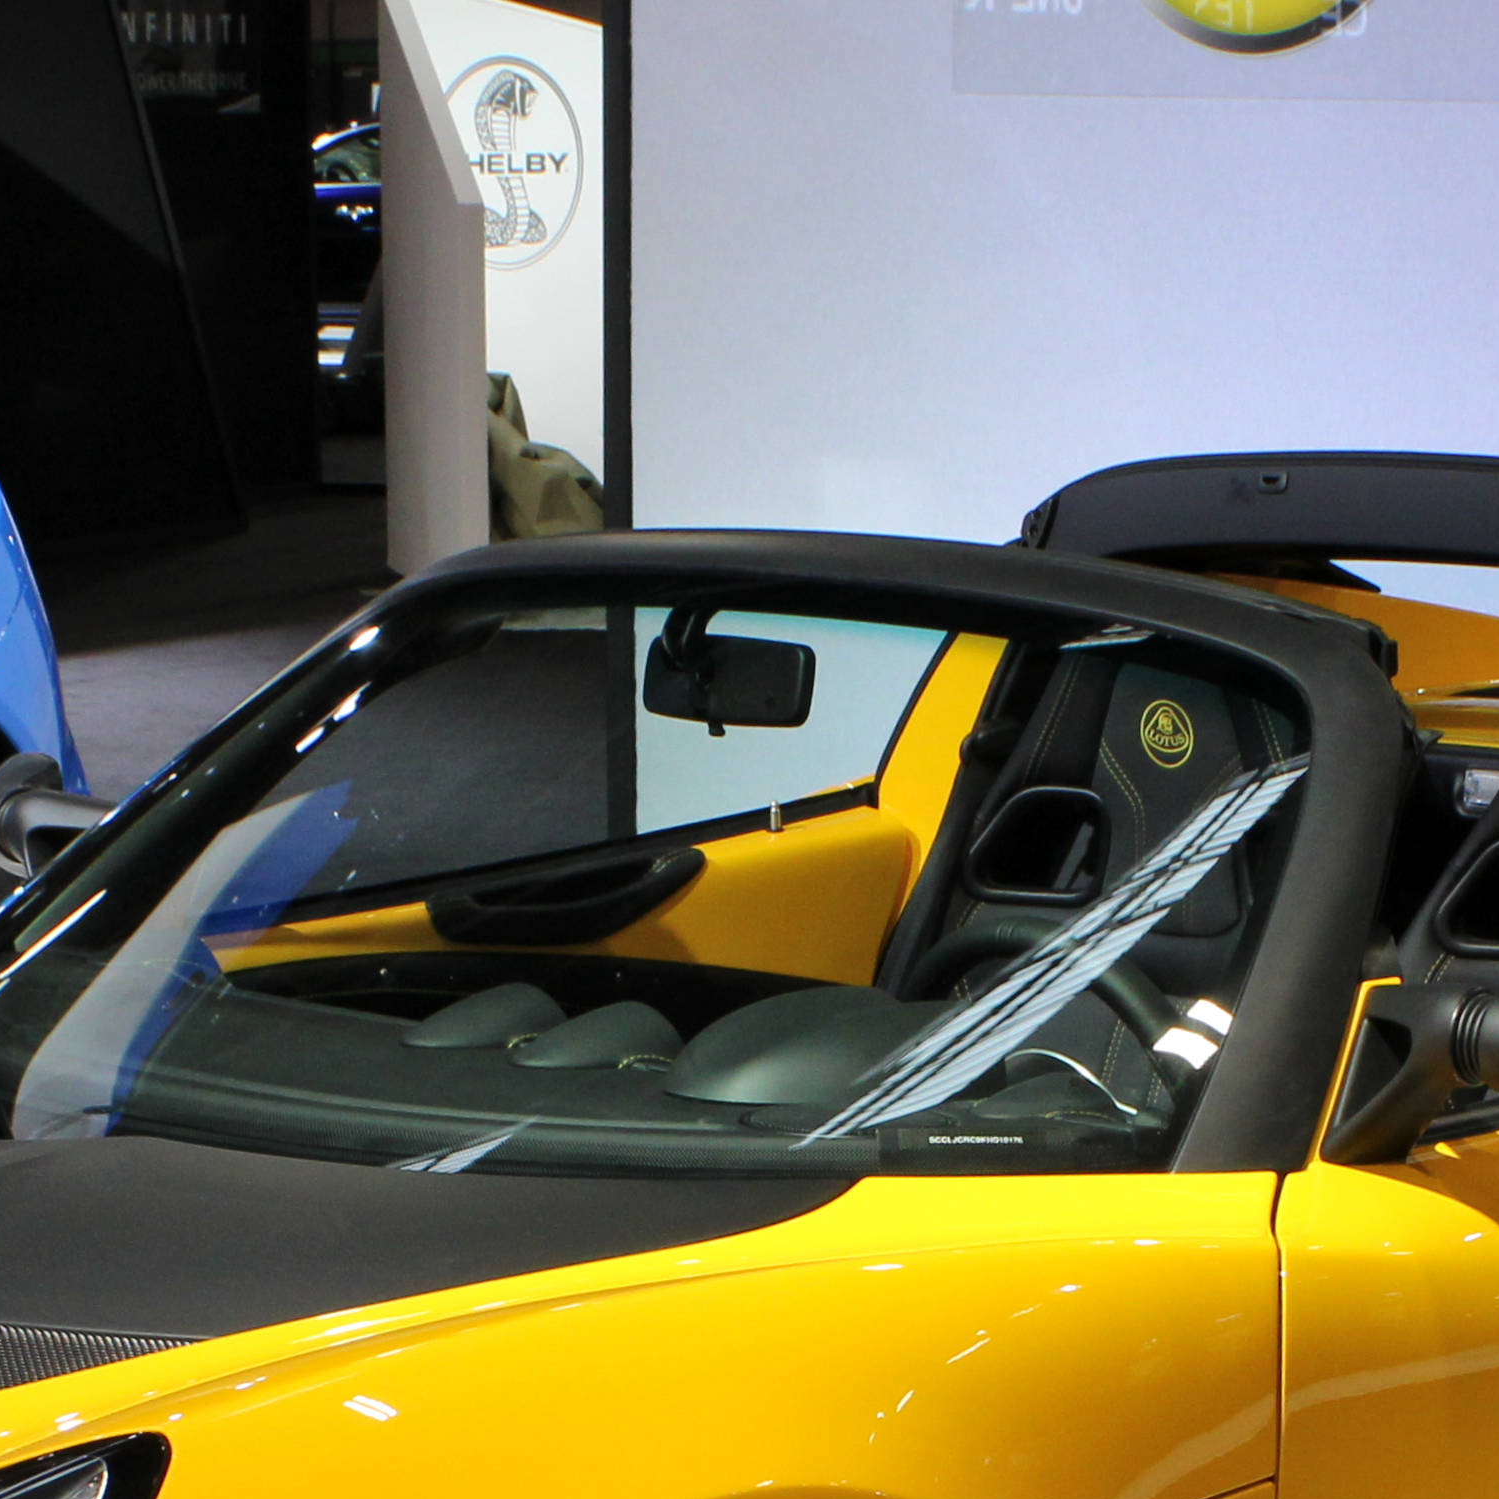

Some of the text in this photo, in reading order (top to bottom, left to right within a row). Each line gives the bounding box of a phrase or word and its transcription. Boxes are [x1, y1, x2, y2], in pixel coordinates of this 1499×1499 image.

[121, 11, 248, 45] NFINITI
[468, 152, 569, 175] HELBY
[1148, 729, 1185, 747] LOTUS
